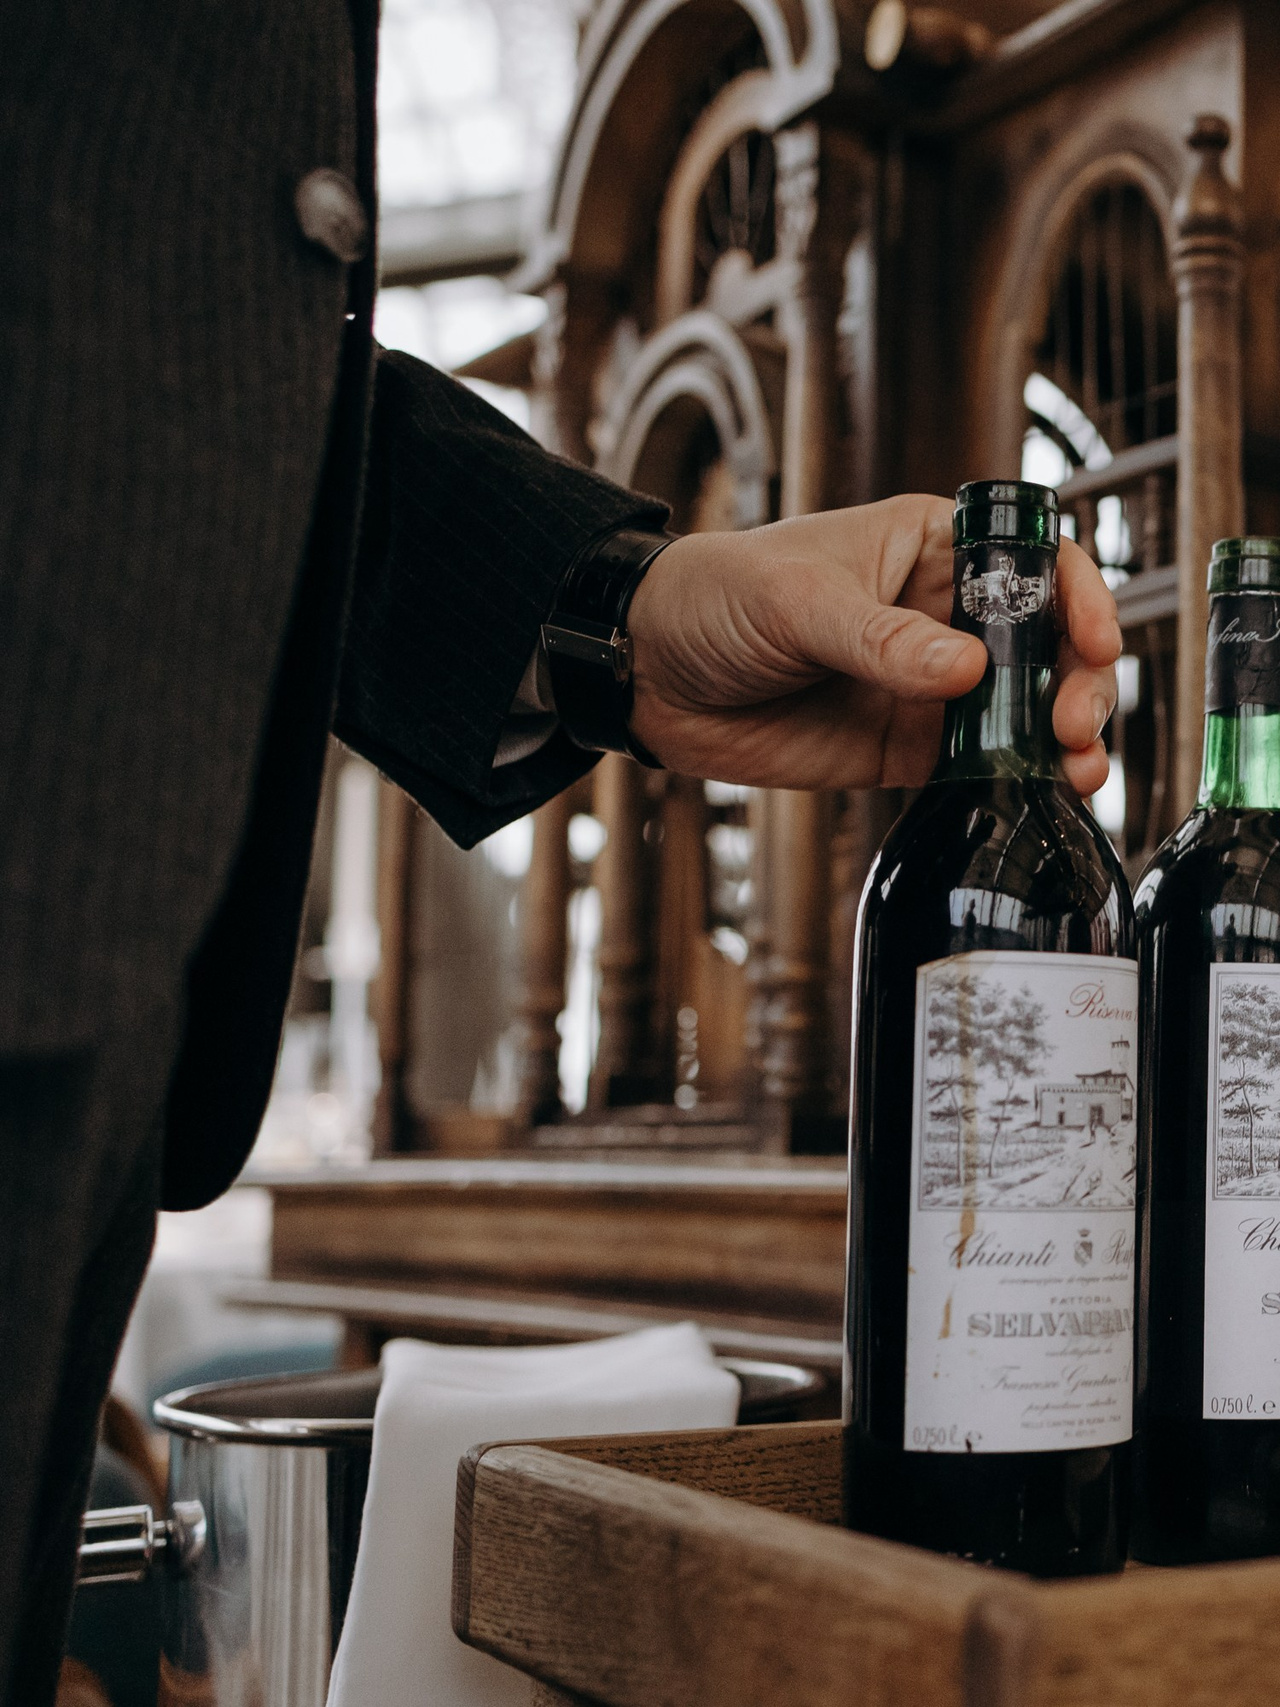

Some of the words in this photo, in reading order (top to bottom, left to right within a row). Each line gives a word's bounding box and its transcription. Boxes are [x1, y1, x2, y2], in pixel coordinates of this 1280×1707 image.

[944, 1229, 1056, 1268] Chianti
[1050, 1296, 1112, 1305] FATTORIA
[1211, 1397, 1243, 1415] 0,750
